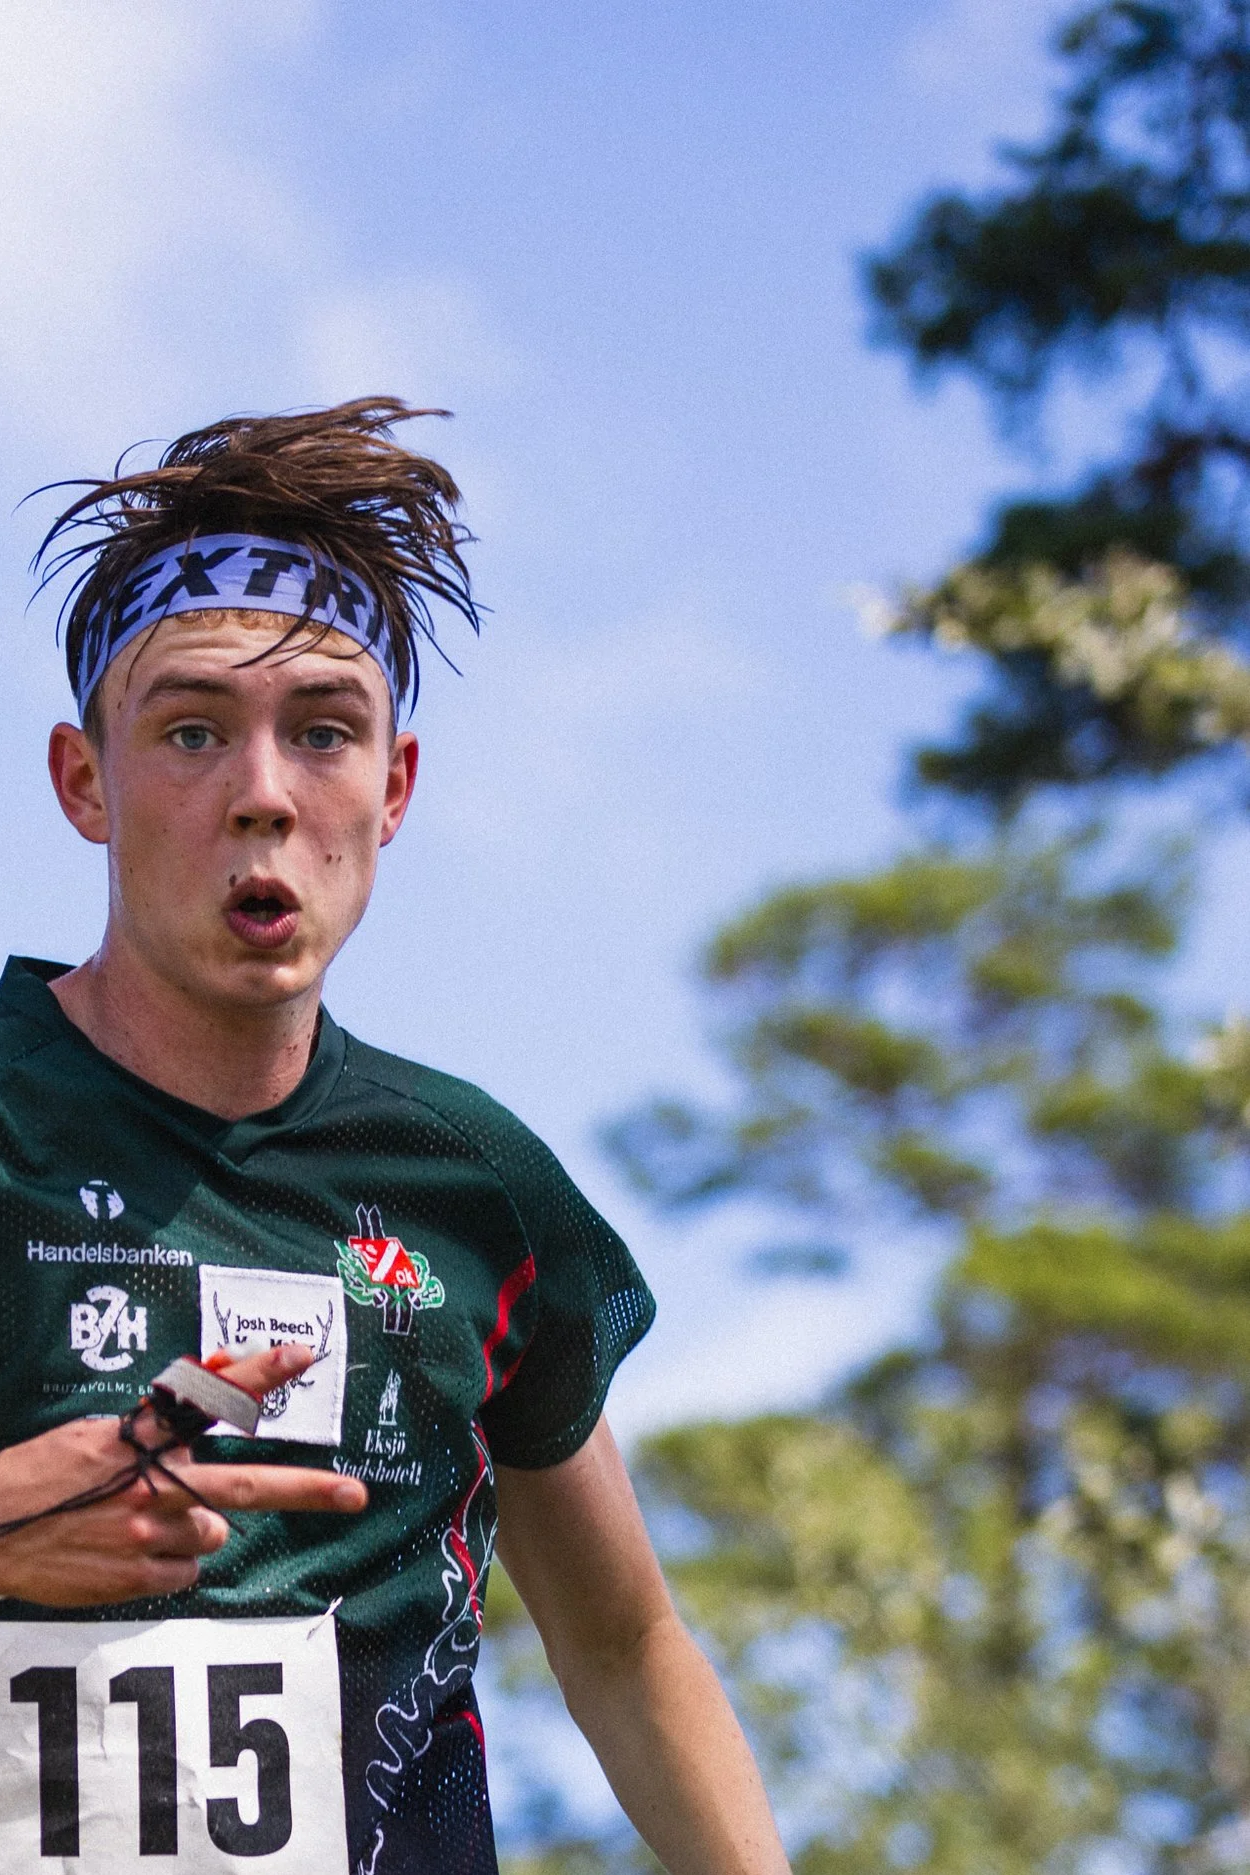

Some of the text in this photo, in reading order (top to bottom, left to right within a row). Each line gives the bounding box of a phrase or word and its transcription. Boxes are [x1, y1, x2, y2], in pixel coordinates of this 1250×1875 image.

[27, 1240, 193, 1267] Handelsbanken
[236, 1315, 314, 1336] Josh Beech
[365, 1429, 406, 1460] Eksjö
[10, 1662, 292, 1858] 115
